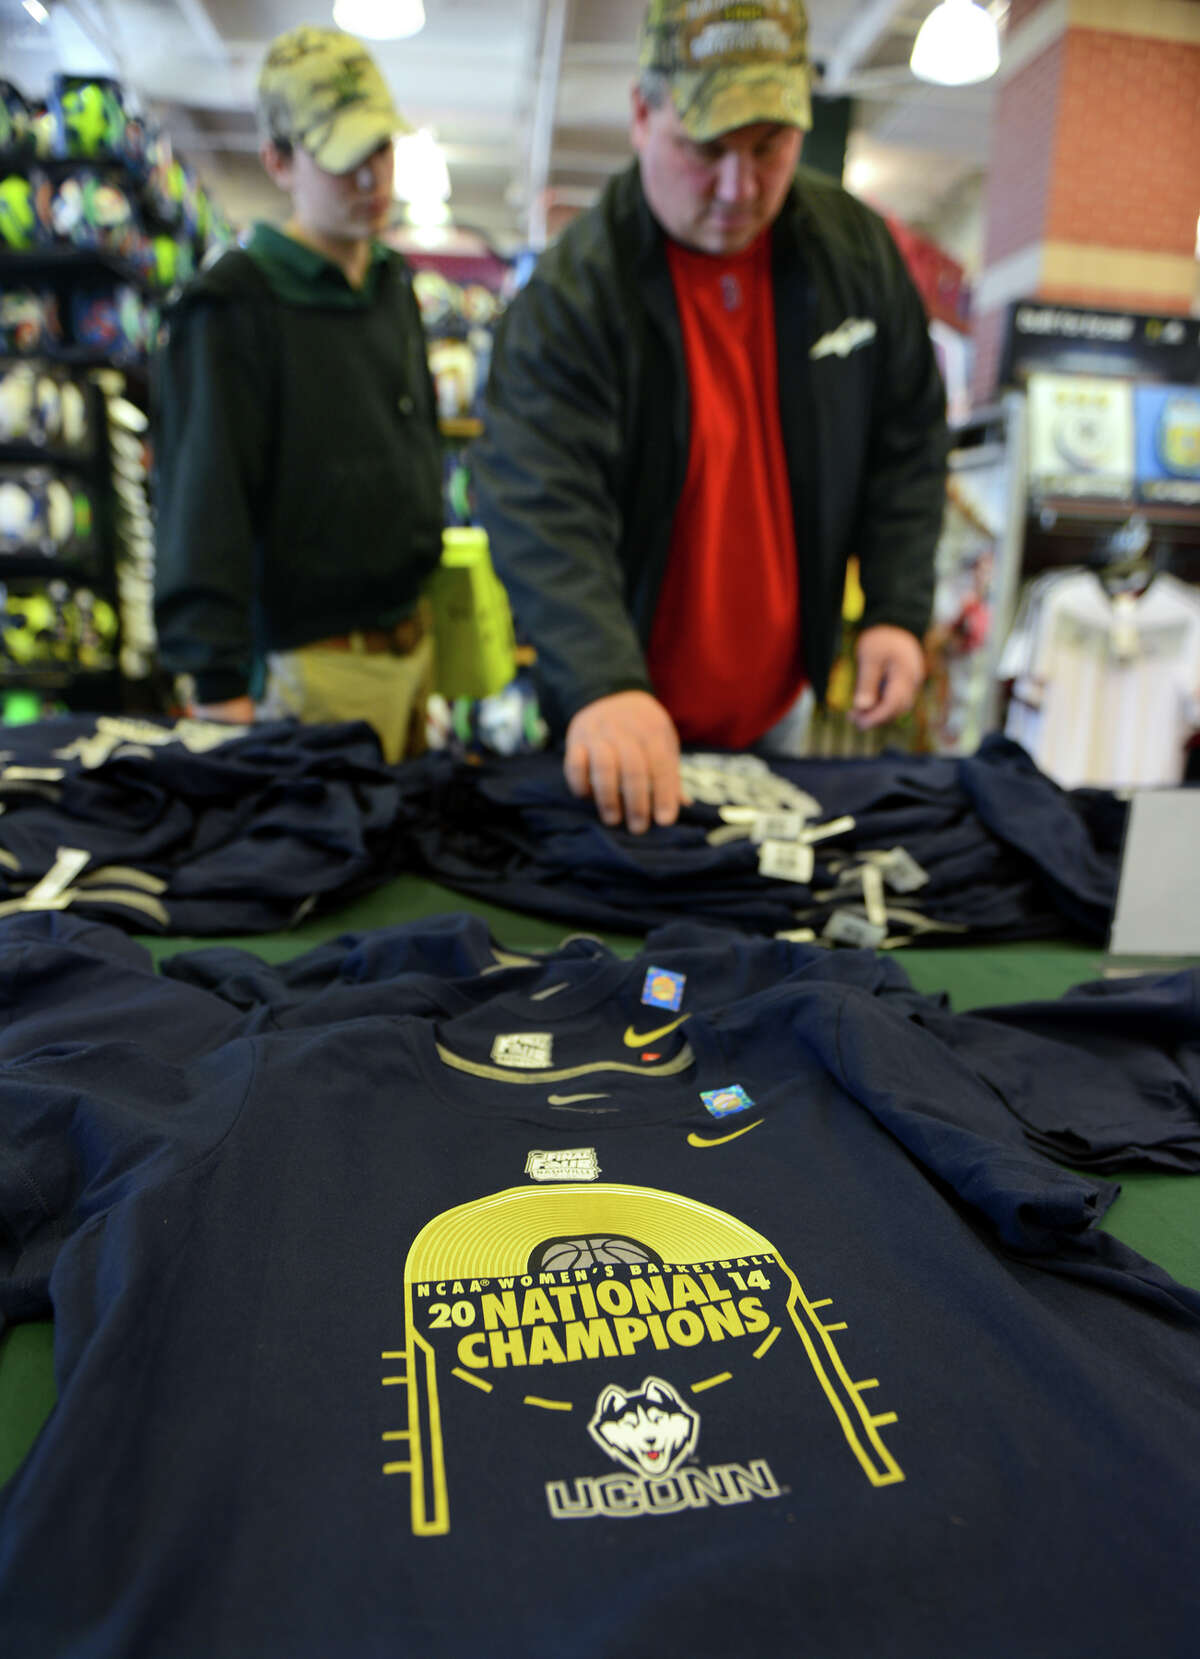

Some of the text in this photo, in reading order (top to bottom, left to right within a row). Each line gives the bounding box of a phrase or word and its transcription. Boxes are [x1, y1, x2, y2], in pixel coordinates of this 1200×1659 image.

[428, 1269, 771, 1331] 20 NATIONAL 14
[498, 1265, 614, 1289] WOMEN'S
[629, 1255, 776, 1276] BASKETBALL
[457, 1296, 771, 1369] CHAMPIONS
[546, 1459, 781, 1518] UCONN
